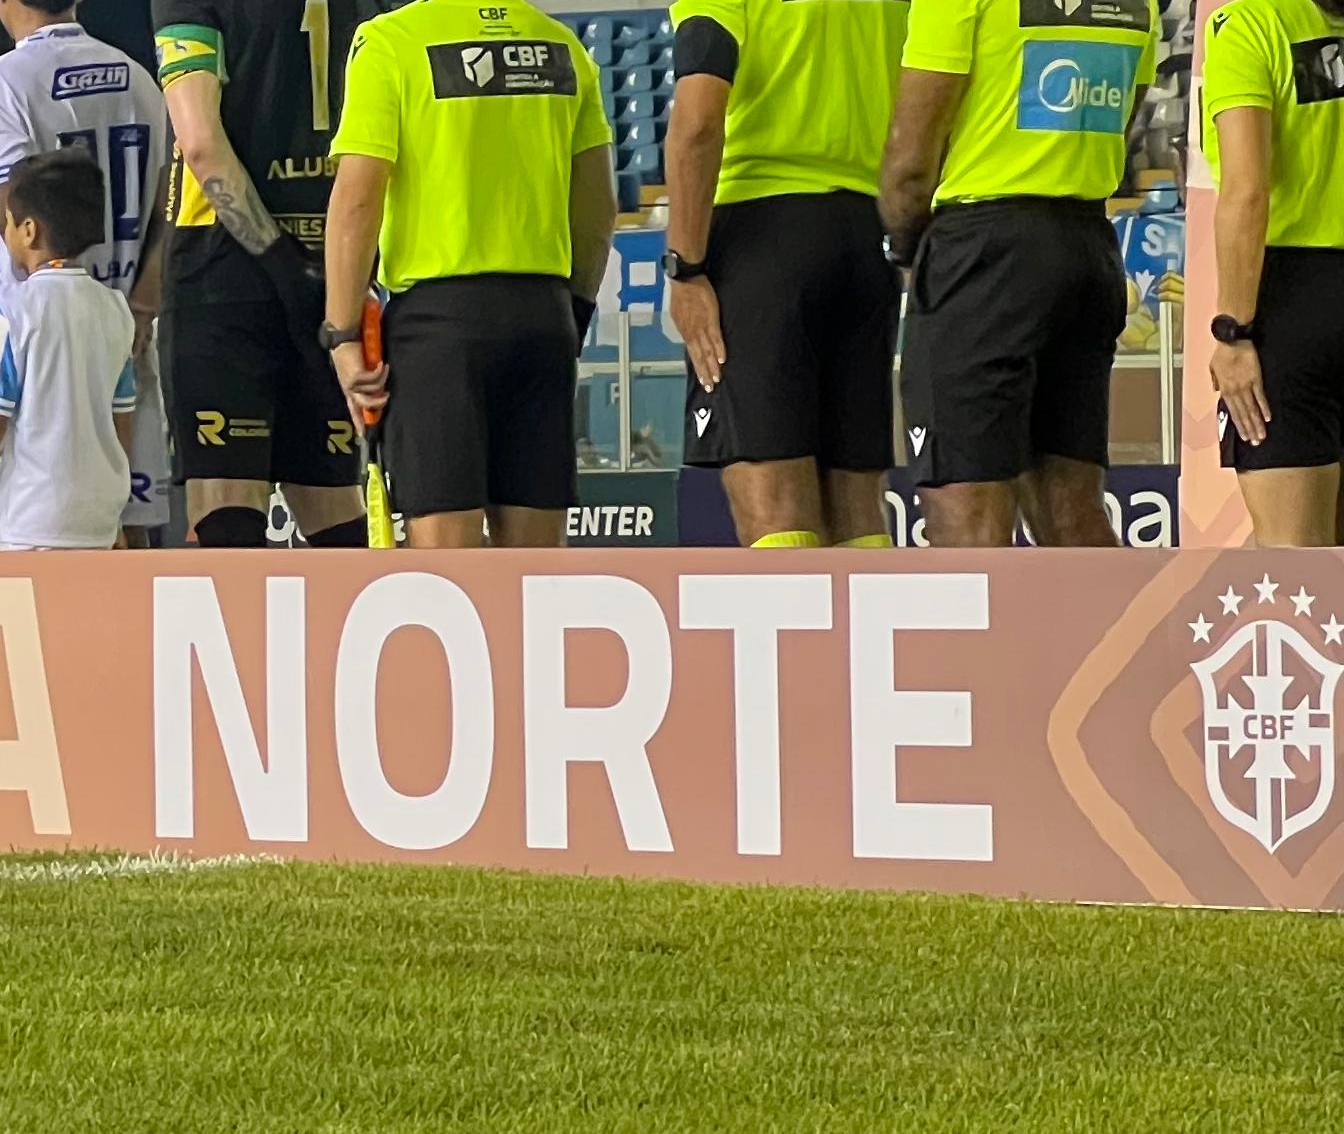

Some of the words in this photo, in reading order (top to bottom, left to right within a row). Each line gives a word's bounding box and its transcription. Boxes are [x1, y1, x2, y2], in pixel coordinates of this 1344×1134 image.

[479, 8, 507, 20] CBF
[502, 46, 549, 67] CBF
[267, 157, 336, 180] ALUB
[152, 570, 994, 862] NORTE
[1243, 714, 1294, 740] CBF
